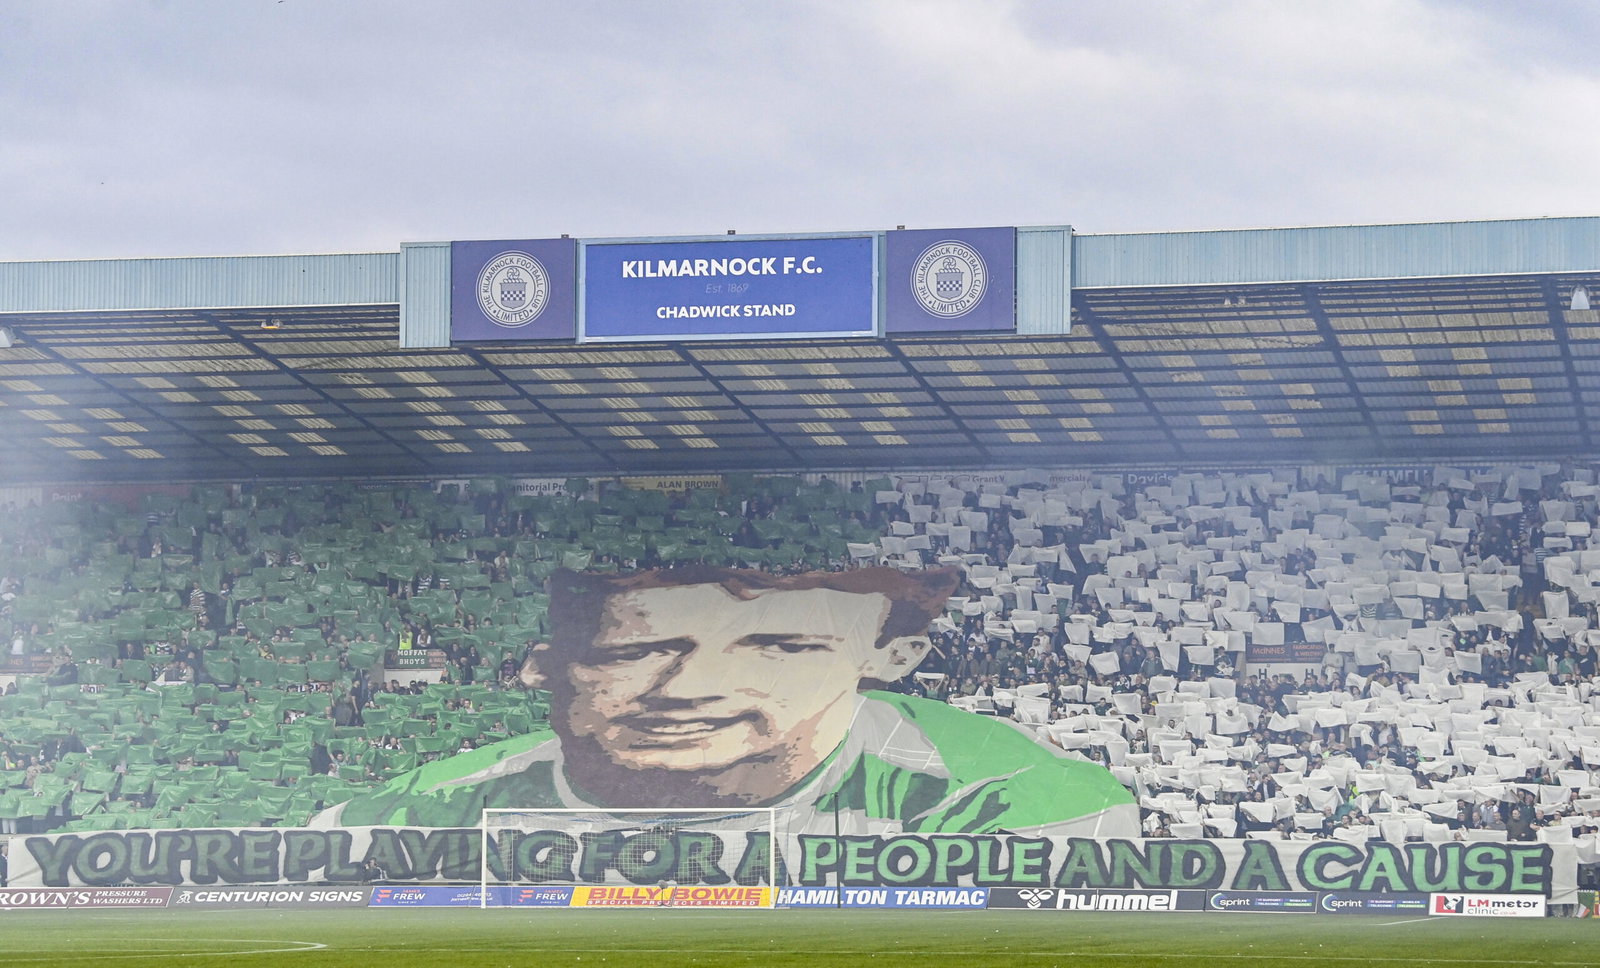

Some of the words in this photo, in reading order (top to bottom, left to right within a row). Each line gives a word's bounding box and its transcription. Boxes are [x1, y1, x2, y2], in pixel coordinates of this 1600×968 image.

[622, 257, 777, 278] KILMARNOCK
[783, 256, 823, 275] F.C.
[917, 246, 951, 284] KILMARNOCK
[952, 246, 981, 278] FOOTBALL
[482, 257, 515, 293] KILMARNOCK
[516, 257, 544, 288] FOOTBALL
[705, 284, 723, 294] Est.
[727, 283, 749, 293] 1869
[918, 285, 929, 301] THE
[968, 279, 982, 299] CLUB
[484, 296, 494, 310] THE
[531, 289, 544, 309] CLUB
[931, 299, 967, 313] LIMITED
[495, 309, 530, 322] LIMITED
[656, 304, 741, 319] CHADWICK
[743, 303, 796, 318] STAND
[1252, 647, 1286, 655] McINNES
[25, 829, 282, 886] YOU'RE
[283, 828, 580, 884] PLAYING
[579, 831, 731, 885] FOR
[734, 831, 793, 886] A
[798, 834, 1054, 888] PEOPLE
[1054, 837, 1226, 891] AND
[1231, 839, 1293, 890] A
[1296, 842, 1554, 899] CAUSE
[0, 891, 91, 905] ROWN'S
[195, 891, 304, 902] CENTURION
[308, 891, 363, 902] SIGNS
[588, 888, 662, 899] BILLY
[670, 888, 762, 900] BOWIE
[777, 890, 887, 905] HAMILTON
[894, 890, 985, 905] TARMAC
[1056, 889, 1178, 910] hummel
[1219, 898, 1250, 907] sprint
[1331, 899, 1362, 908] sprint
[1468, 899, 1489, 907] LM
[1467, 907, 1499, 915] clinic
